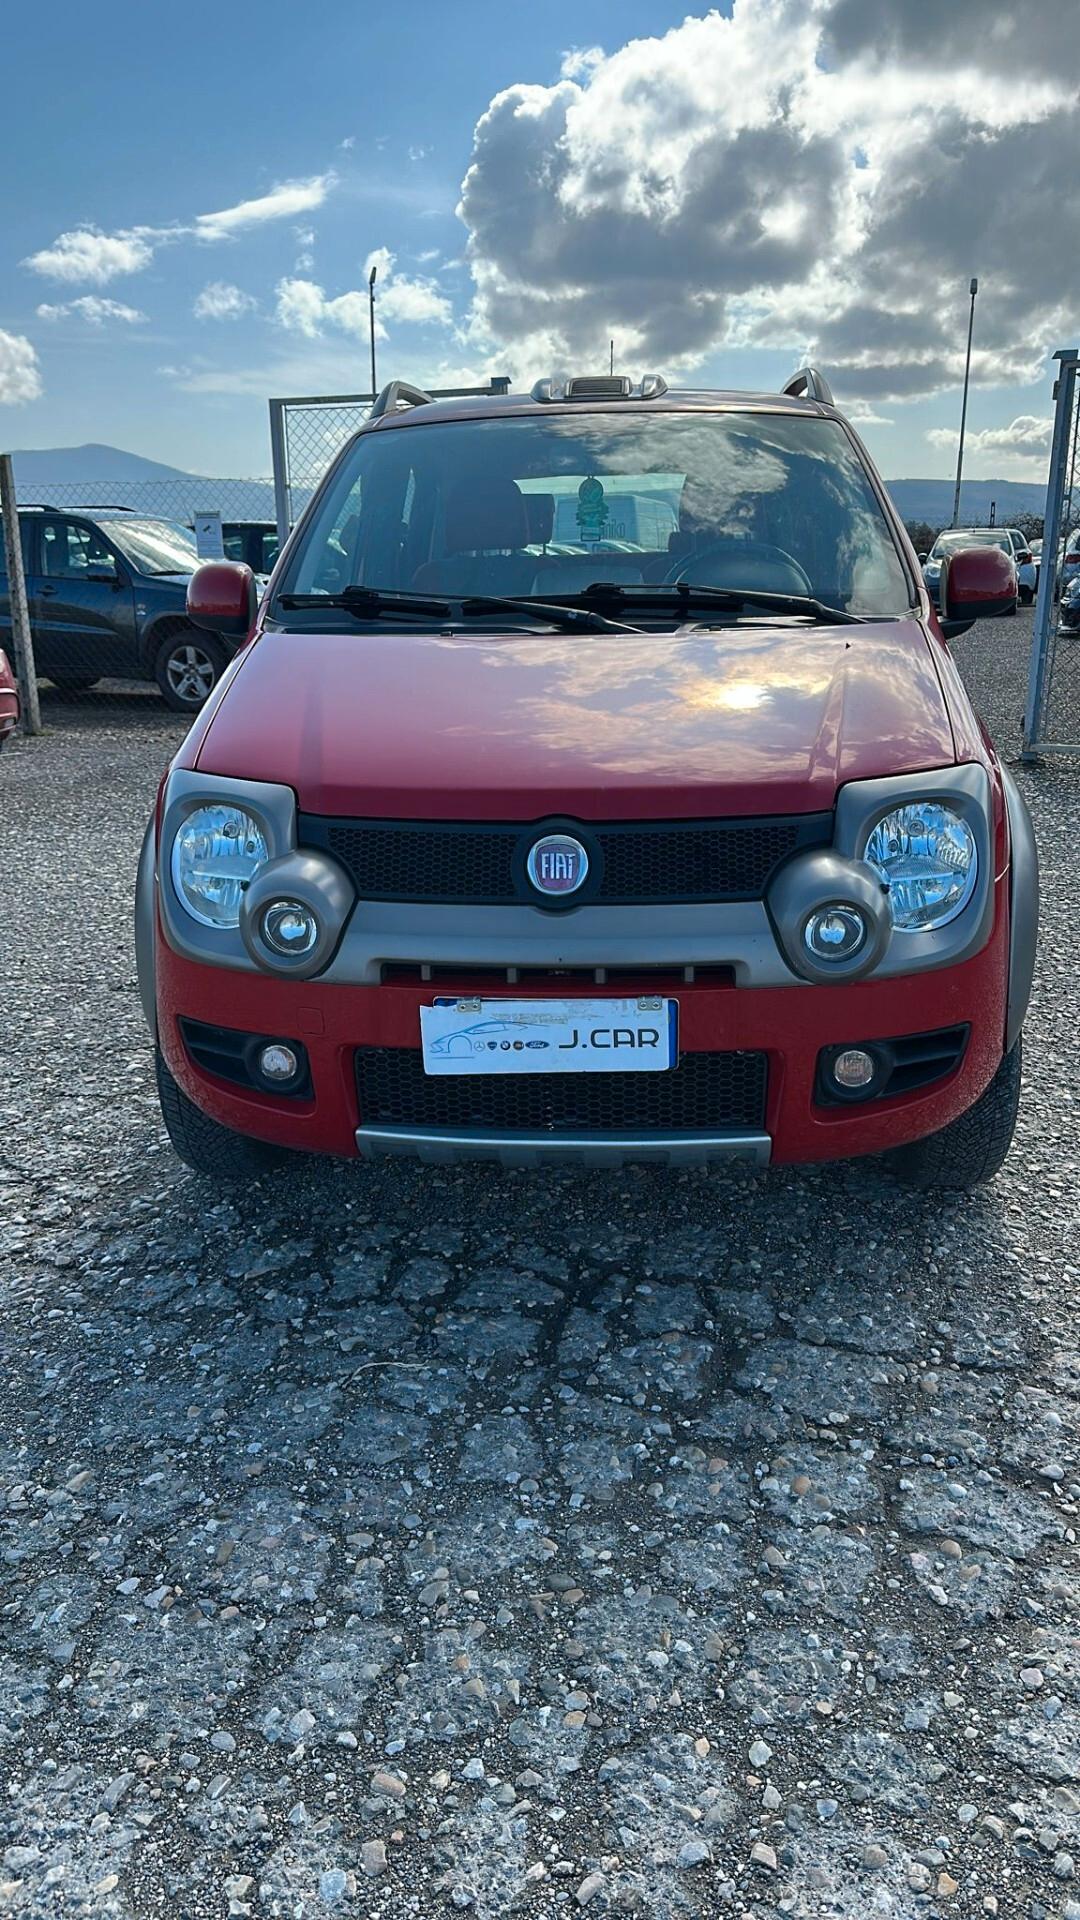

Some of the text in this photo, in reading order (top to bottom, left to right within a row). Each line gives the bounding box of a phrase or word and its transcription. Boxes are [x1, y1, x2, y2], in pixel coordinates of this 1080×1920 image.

[541, 852, 576, 880] FIAT
[527, 1040, 547, 1049] Ford
[558, 1028, 660, 1049] J.CAR
